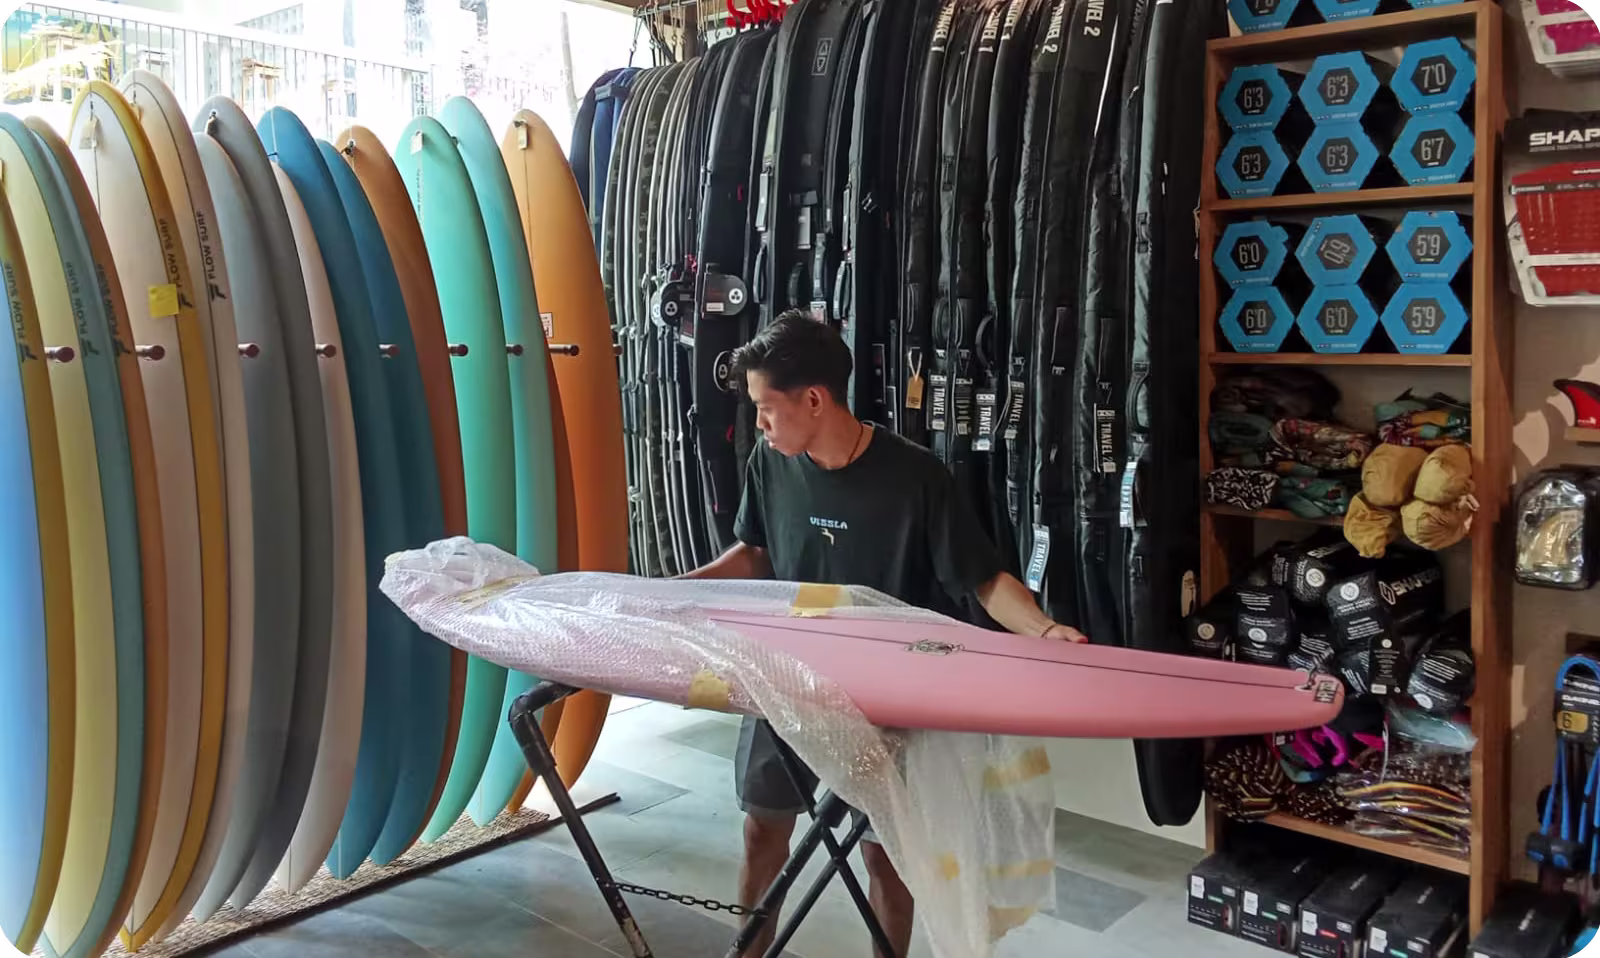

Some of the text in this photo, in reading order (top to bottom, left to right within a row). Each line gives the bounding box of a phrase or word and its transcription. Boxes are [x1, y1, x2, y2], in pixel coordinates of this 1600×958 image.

[1083, 26, 1101, 37] 2
[1041, 44, 1058, 54] 2
[1421, 63, 1447, 88] 7'0
[1421, 137, 1445, 160] 6'7
[159, 218, 173, 251] SURF
[196, 210, 217, 280] FLOW SURF
[1416, 234, 1440, 256] 5'9
[12, 301, 25, 338] FLOW
[1412, 306, 1436, 328] 5'9
[933, 388, 945, 416] TRAVEL
[1009, 394, 1024, 423] TRAVEL
[979, 406, 992, 435] TRAVEL
[1101, 423, 1113, 455] TRAVEL
[809, 516, 848, 530] VISSLA
[1031, 544, 1046, 573] TRAVEL
